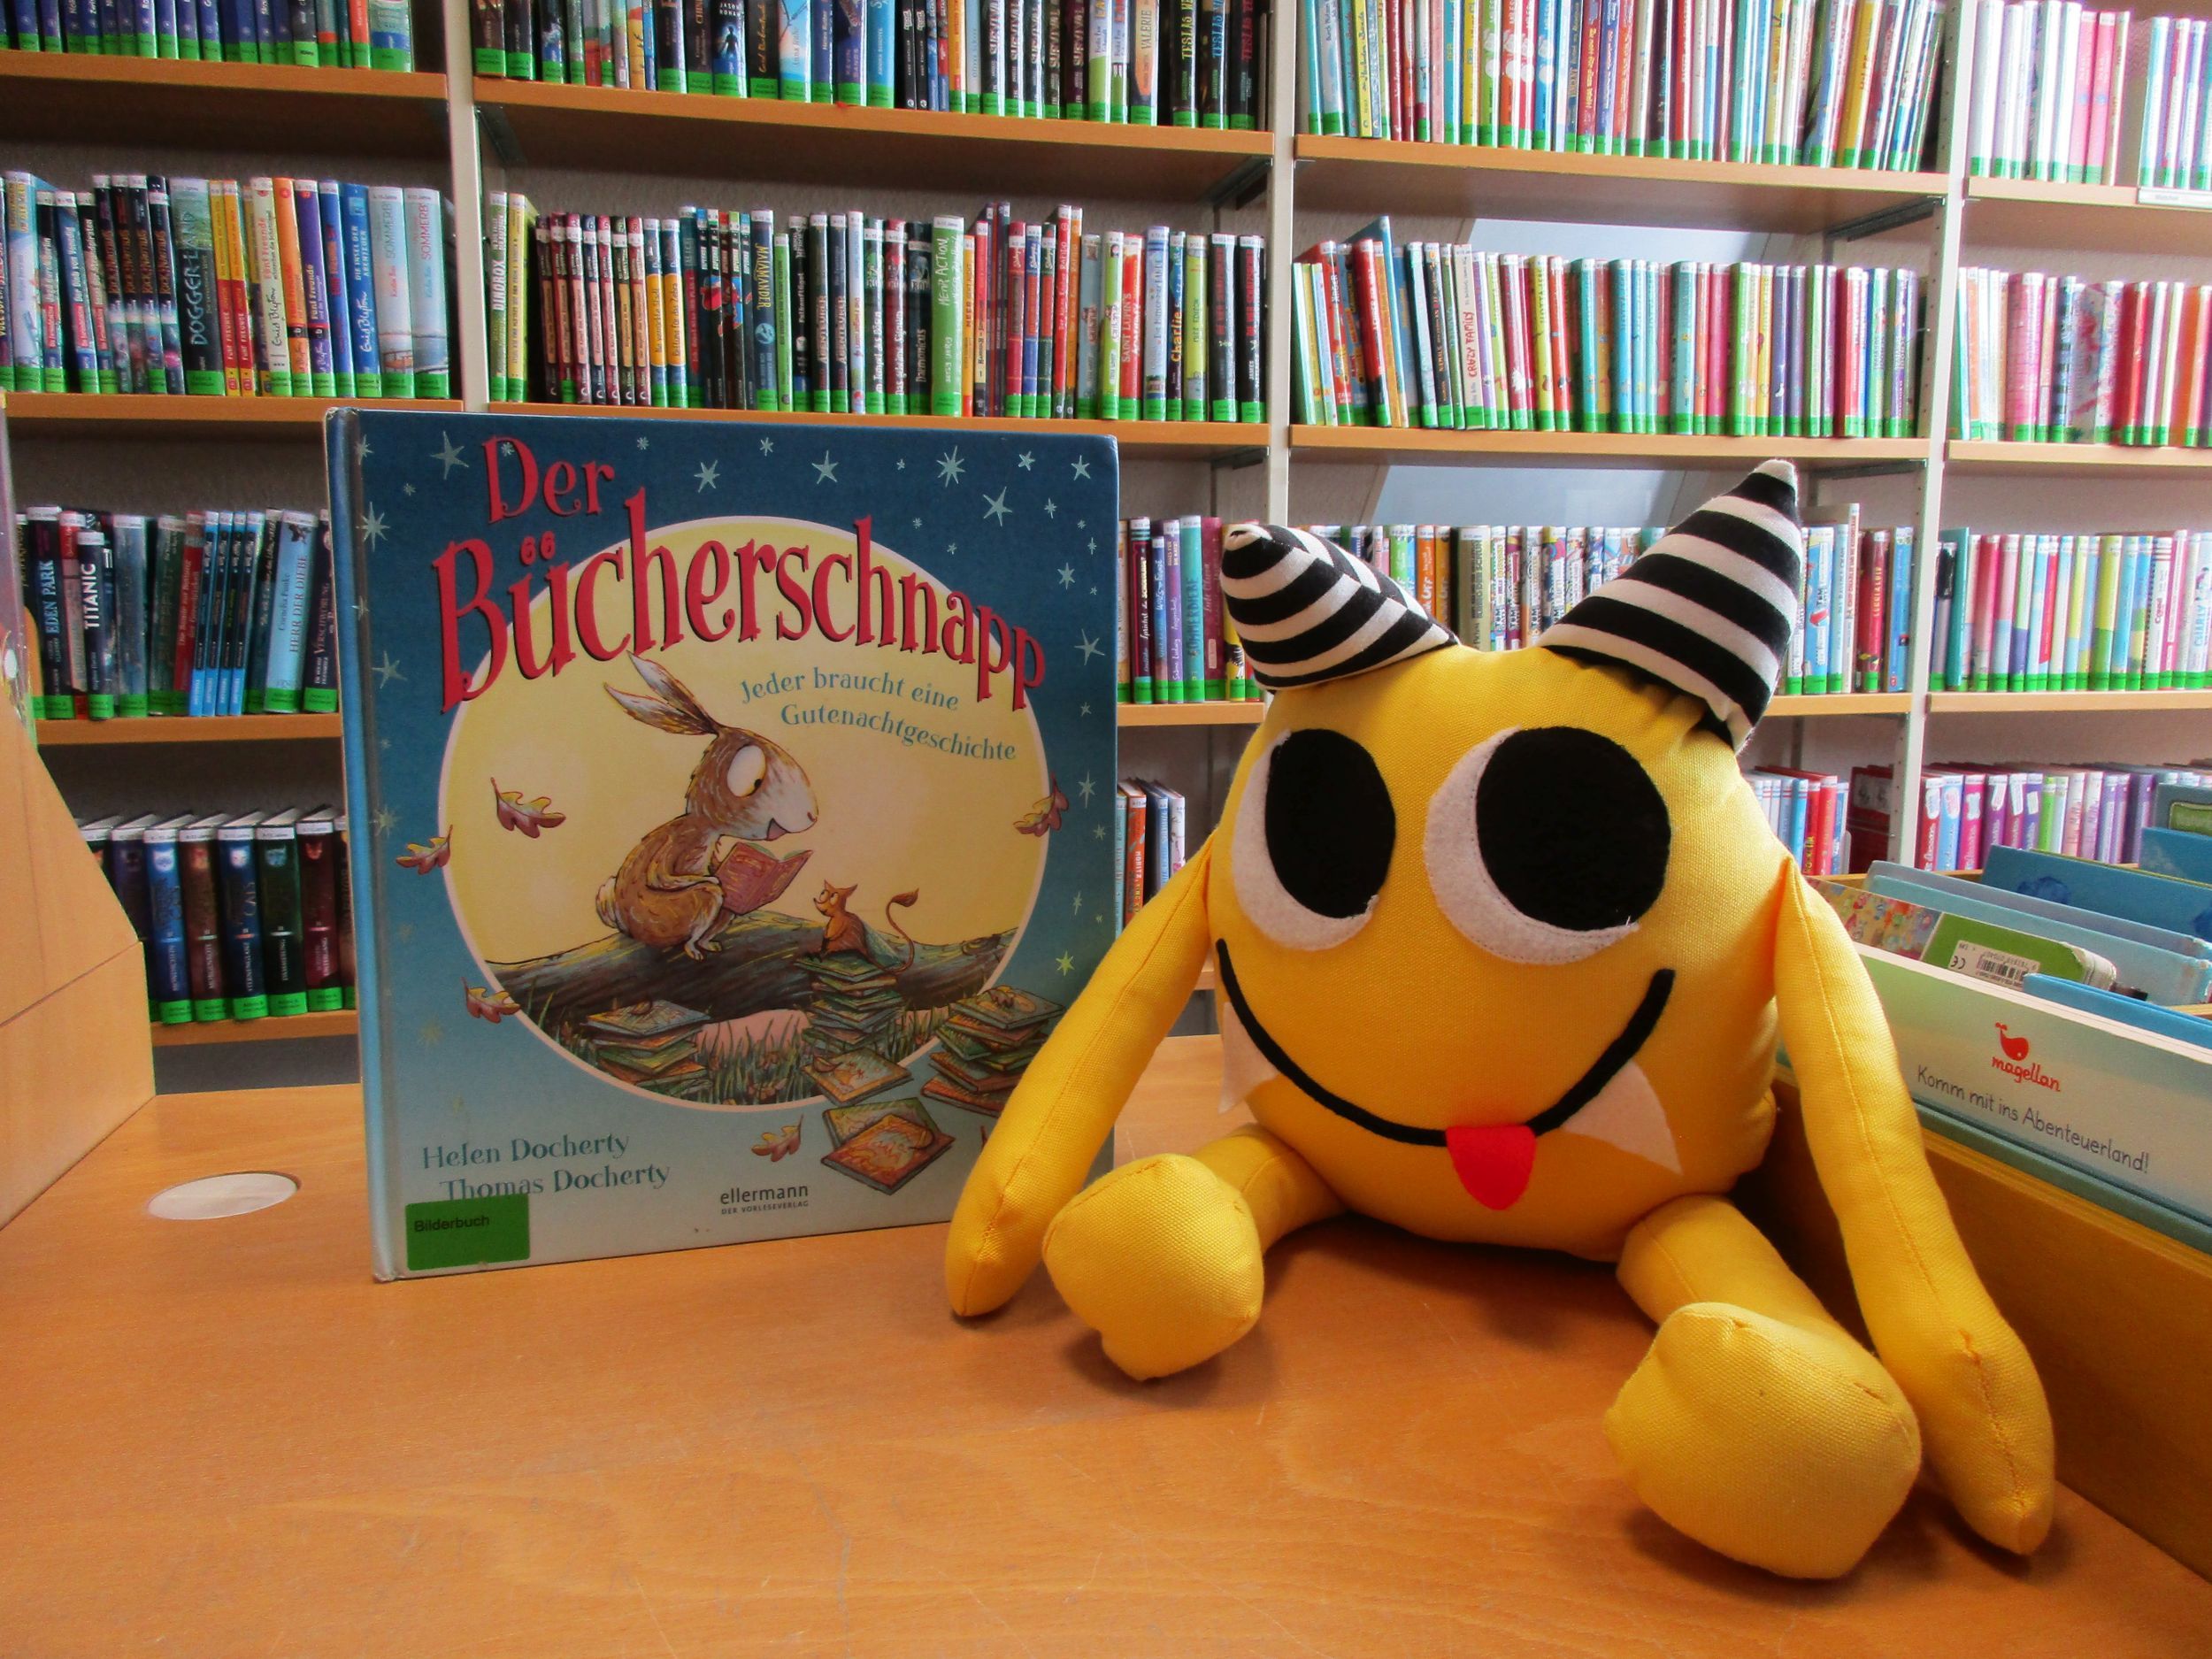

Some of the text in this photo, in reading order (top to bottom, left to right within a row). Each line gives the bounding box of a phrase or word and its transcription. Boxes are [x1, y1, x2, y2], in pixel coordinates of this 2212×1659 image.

[1141, 10, 1152, 50] VALERIE
[382, 201, 396, 259] SOMMERB
[419, 203, 432, 260] SOMMERB
[360, 230, 369, 276] ABENTEUER
[307, 265, 316, 298] Freunde
[755, 242, 772, 310] MALAMANDER
[266, 288, 285, 346] Enid Blyton
[356, 291, 373, 352] Enid Blyton
[1122, 293, 1132, 330] LUPIN'S
[1463, 311, 1477, 343] FAMILY
[1171, 311, 1182, 362] Charlie
[1466, 347, 1478, 378] CRAZY
[482, 435, 616, 524] Der
[38, 560, 57, 595] PARK
[81, 563, 100, 629] TITANIC
[42, 601, 61, 634] EDEN
[278, 573, 290, 631] Cornelia Funke
[289, 555, 307, 653] HERR DER DIEBE
[431, 487, 1047, 714] Bücherschnapp
[741, 666, 959, 711] Jeder braucht eine
[781, 704, 1017, 763] Gutenachtgeschichte
[1991, 1056, 2062, 1092] magellan
[1917, 1064, 2150, 1174] Komm mit ins Abenteuerland!
[423, 1133, 629, 1169] Helen Docherty
[440, 1164, 671, 1202] Thomas Docherty
[719, 1185, 809, 1205] ellermann
[414, 1215, 489, 1233] Bilderbuch
[741, 1202, 809, 1213] VORLESEVERLAG
